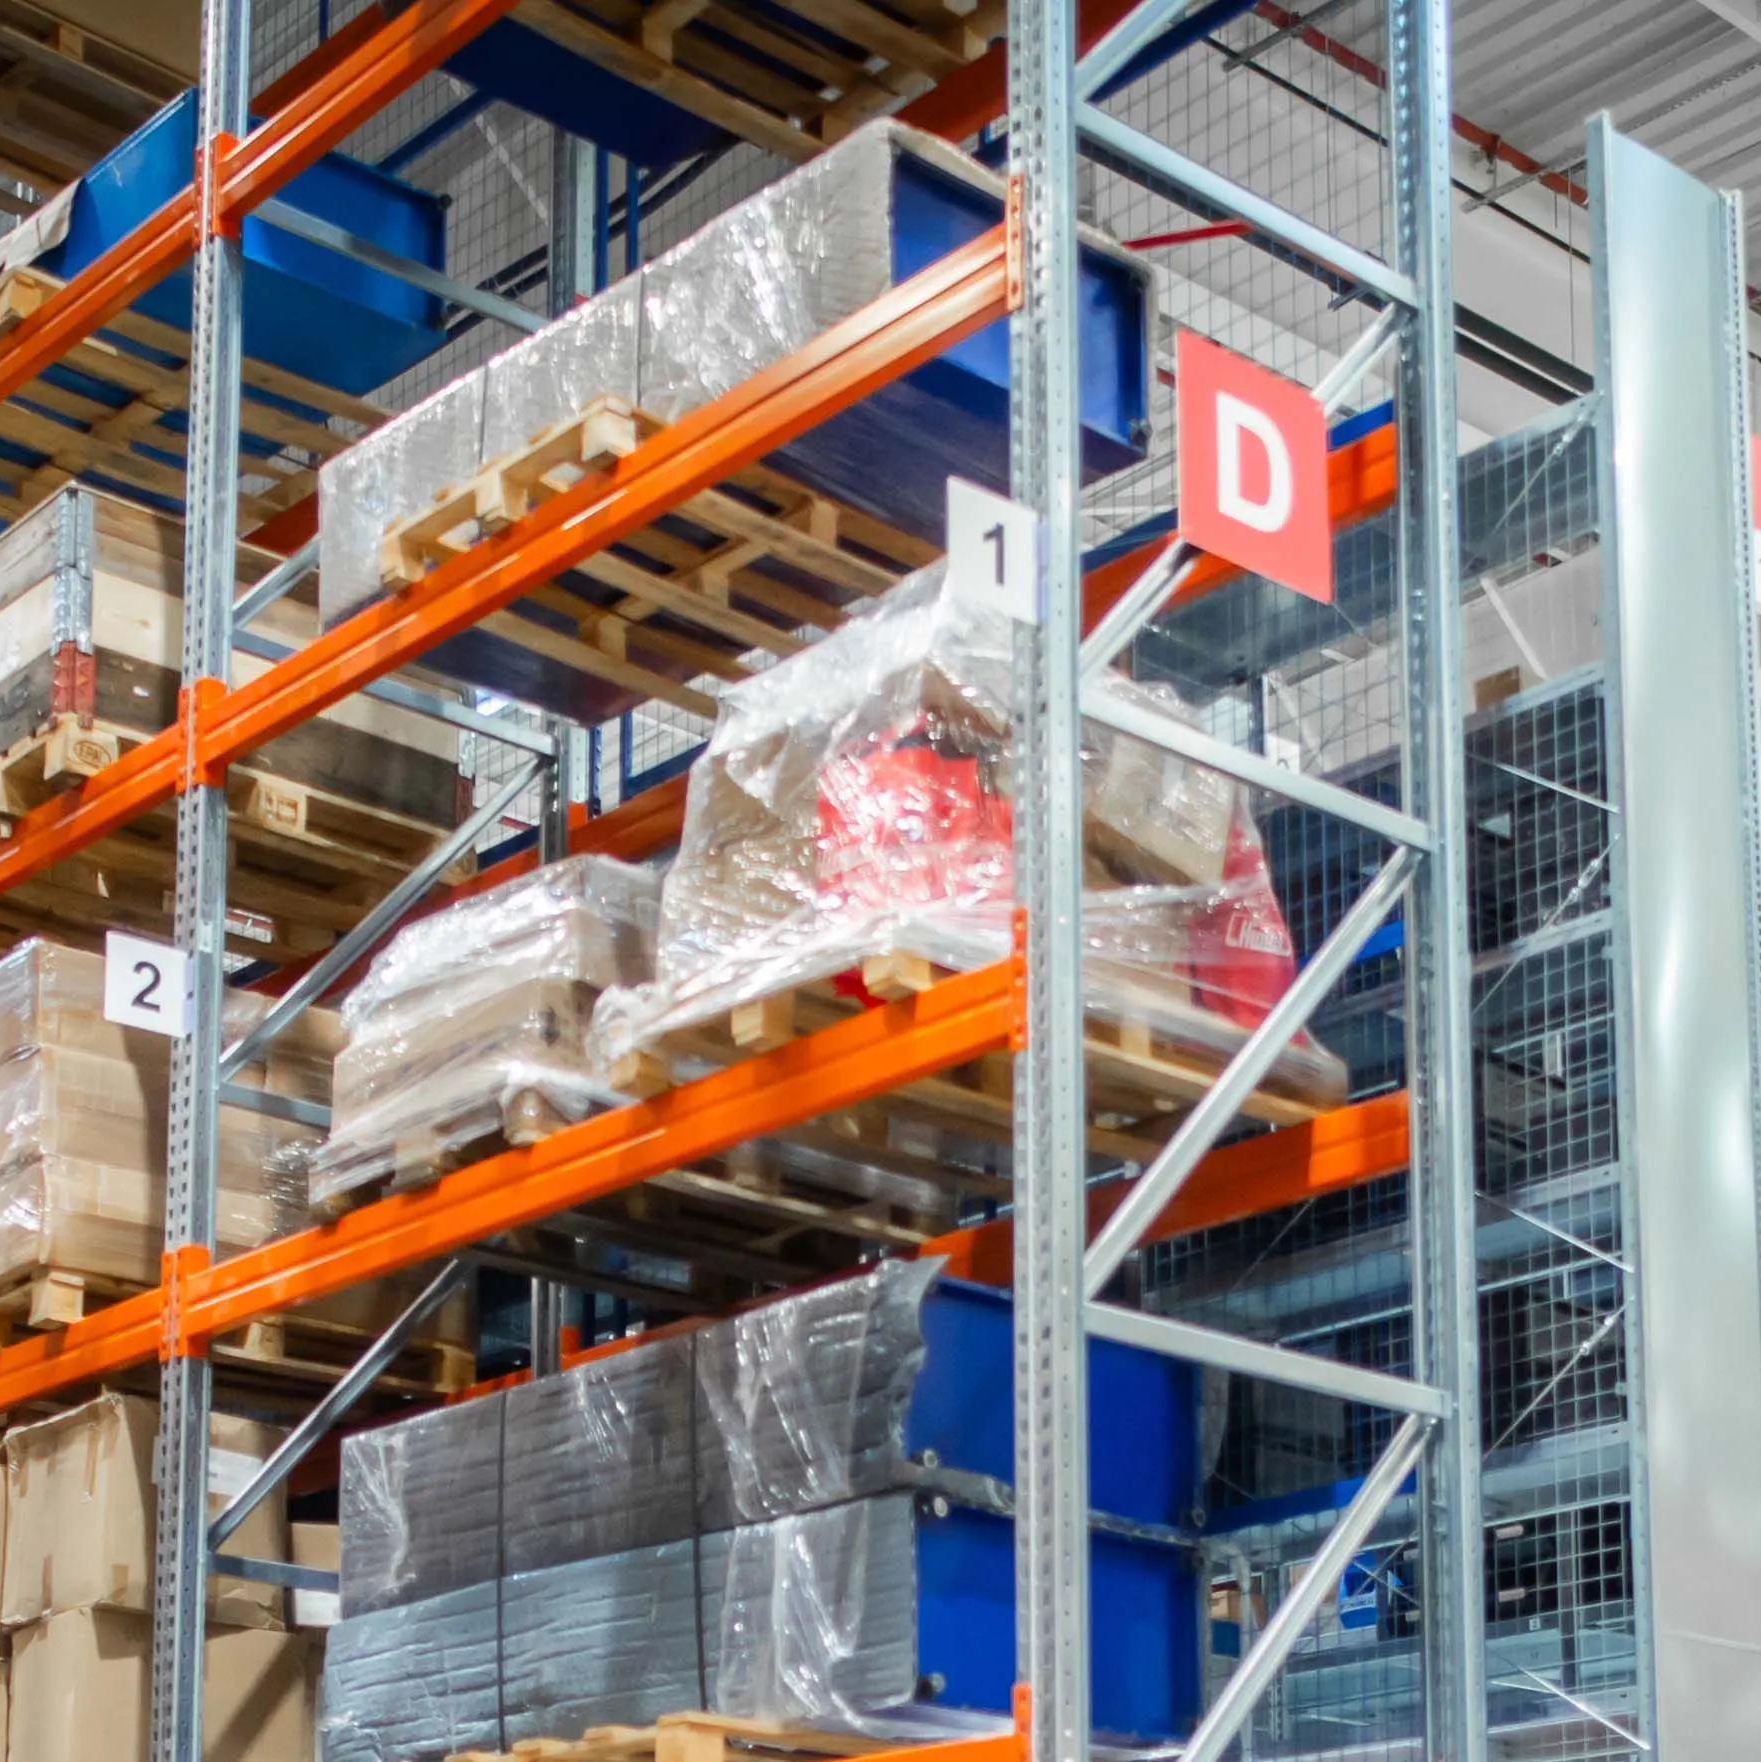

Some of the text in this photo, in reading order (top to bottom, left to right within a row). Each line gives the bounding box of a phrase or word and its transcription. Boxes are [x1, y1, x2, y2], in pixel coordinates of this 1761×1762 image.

[1217, 391, 1292, 533] D
[983, 523, 1005, 586] 1
[131, 961, 161, 1013] 2
